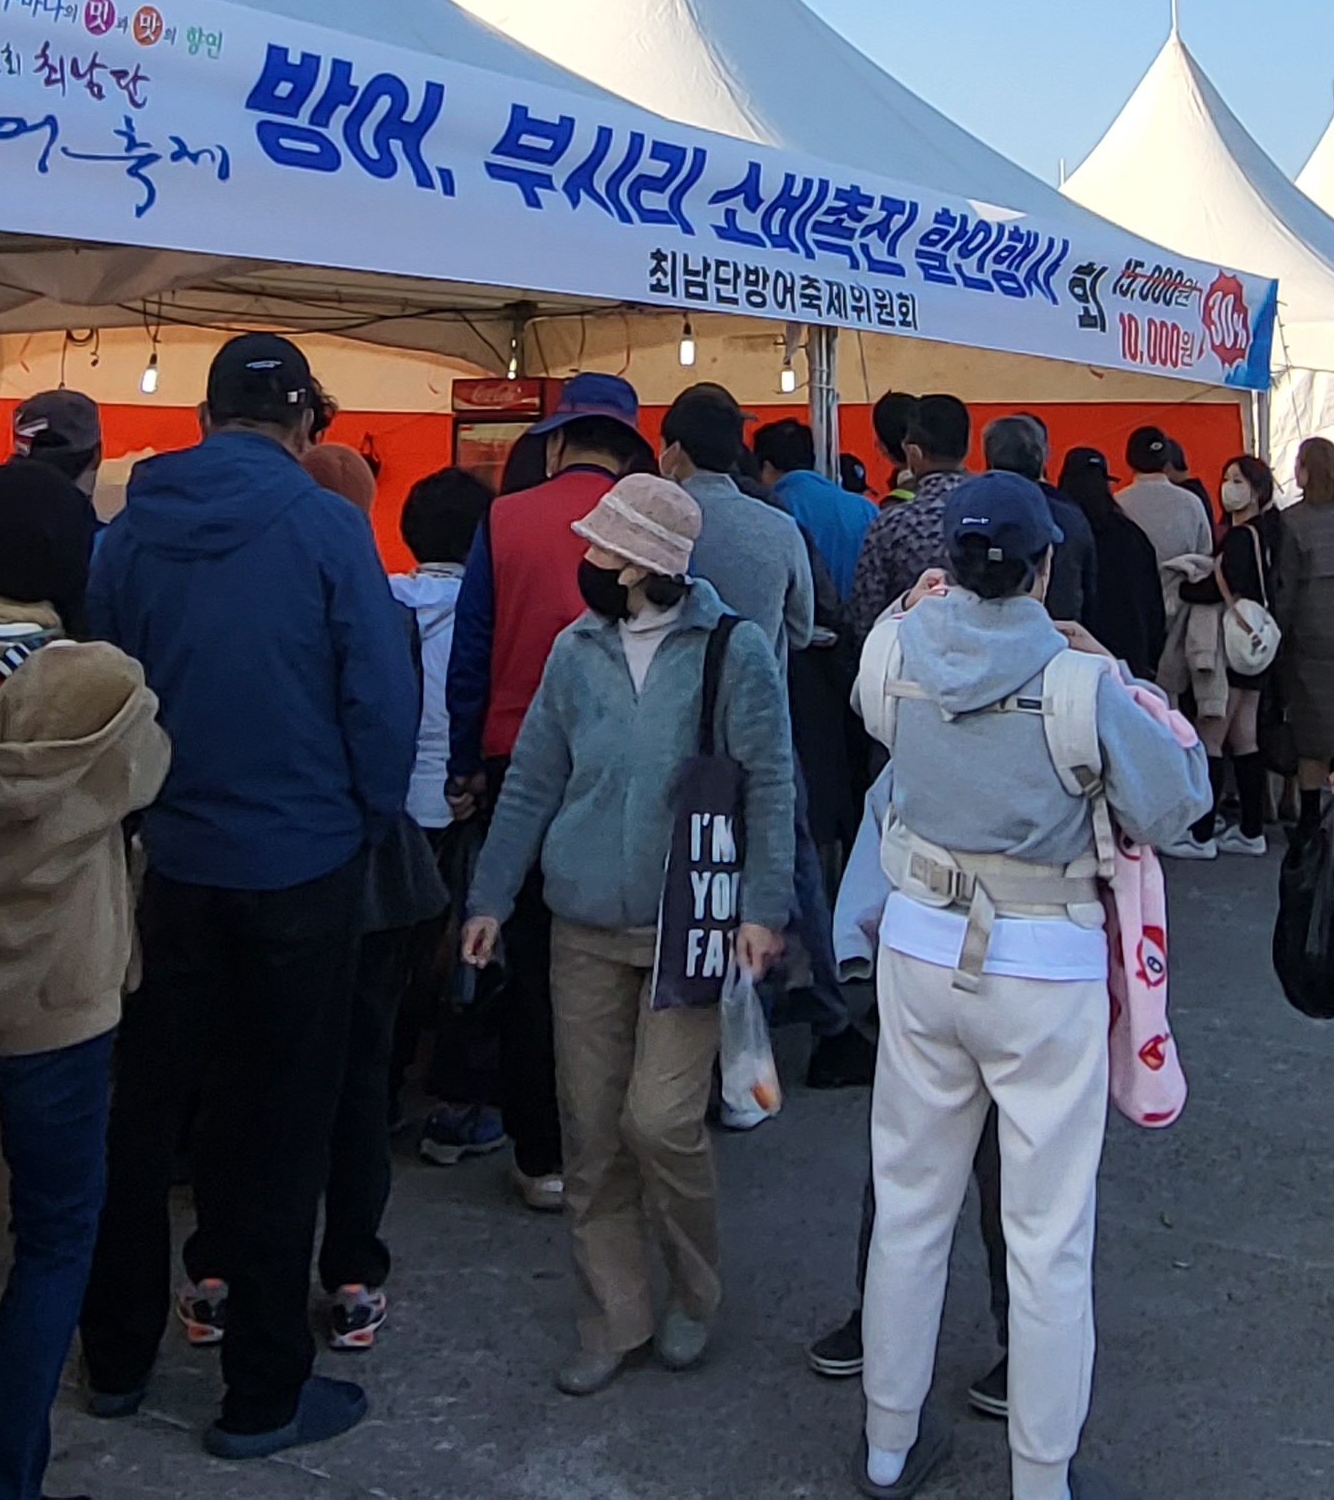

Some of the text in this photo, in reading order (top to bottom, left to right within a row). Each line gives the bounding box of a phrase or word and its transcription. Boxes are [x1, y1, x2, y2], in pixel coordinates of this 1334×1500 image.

[186, 26, 223, 59] 향연
[34, 40, 151, 109] 최남단
[245, 43, 1108, 333] 방어, 부시리 소비촉진 할인행사 회
[648, 246, 920, 331] 최남단방어축제위원회
[1209, 291, 1247, 349] 30%
[690, 813, 737, 863] I'M
[685, 928, 737, 978] FA
